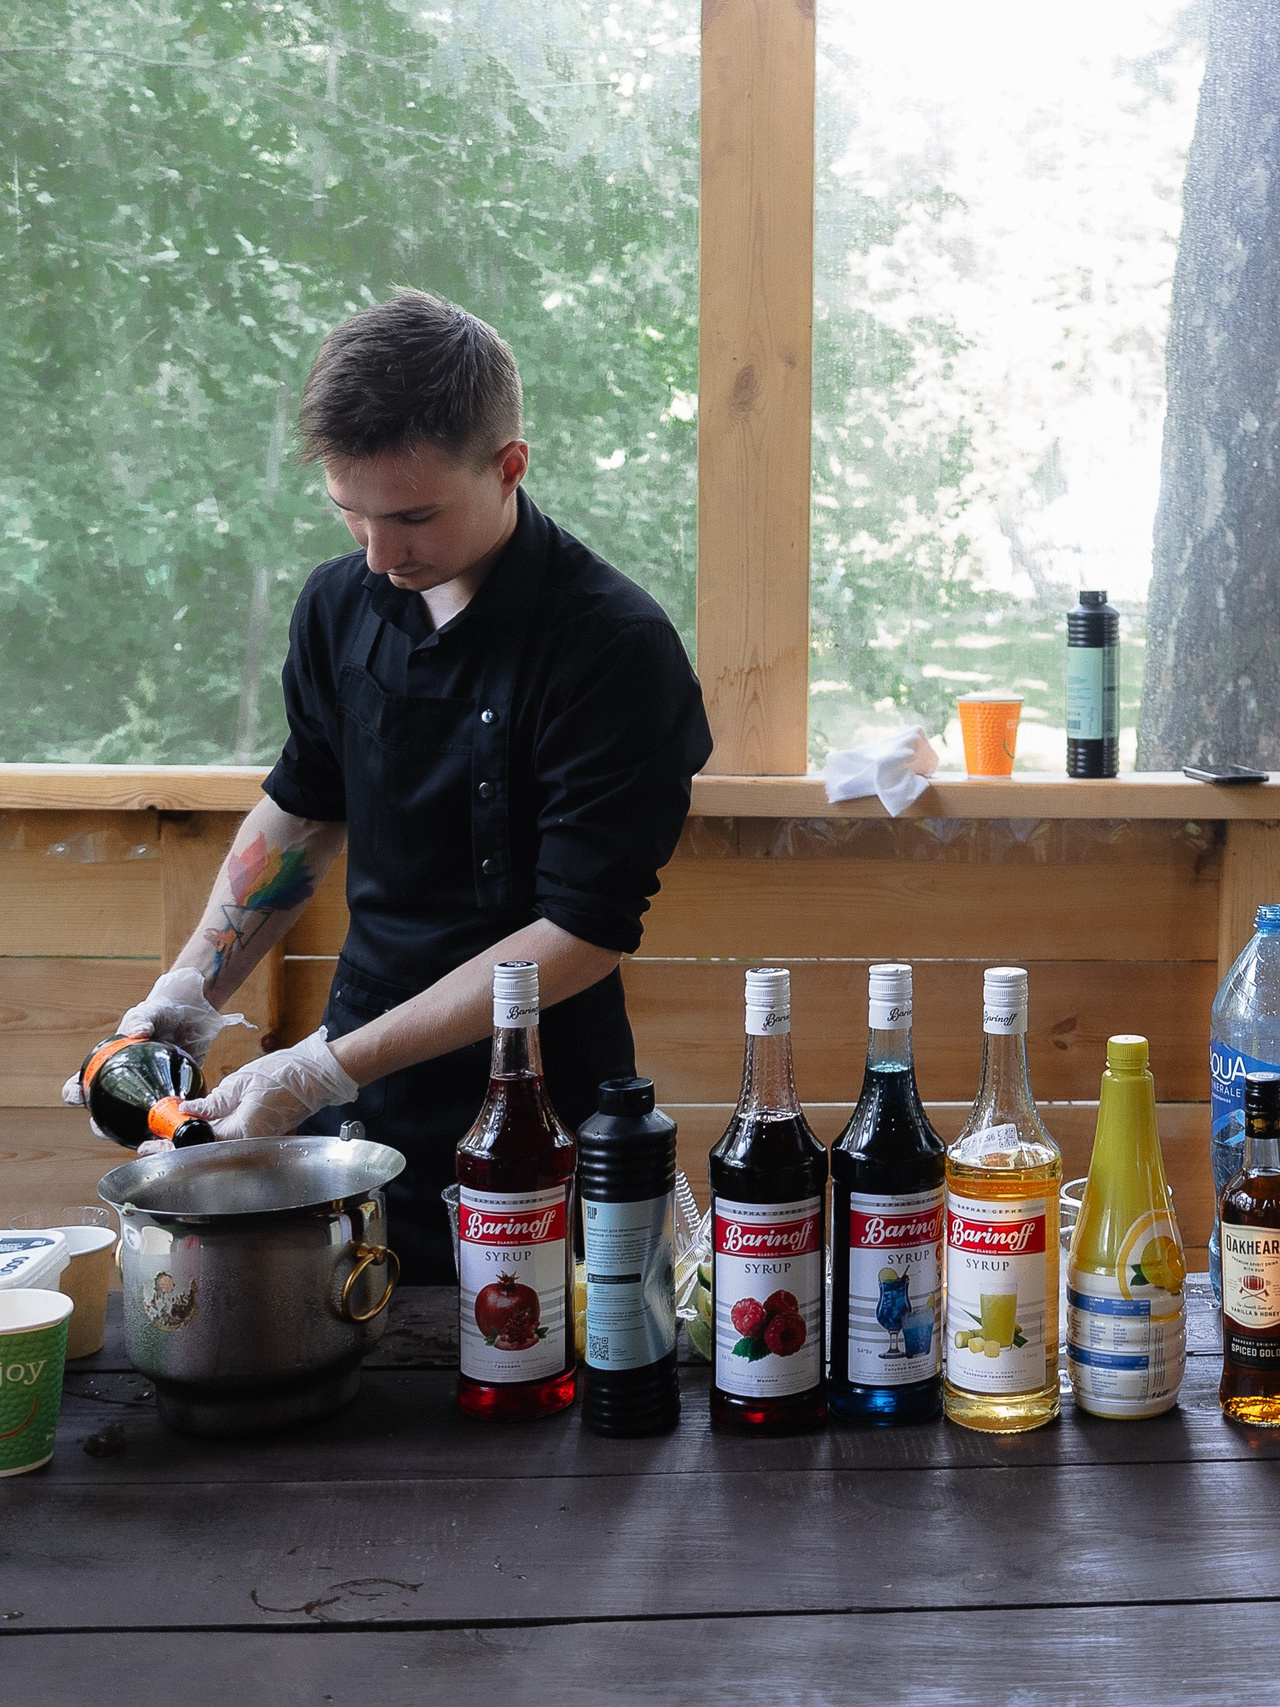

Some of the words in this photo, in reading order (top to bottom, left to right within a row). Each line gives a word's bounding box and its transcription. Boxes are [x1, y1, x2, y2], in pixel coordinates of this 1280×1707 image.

[1210, 1052, 1247, 1086] QUA
[465, 1209, 556, 1240] Barinoff
[860, 1208, 943, 1245] Barinoff
[722, 1220, 814, 1251] Barinoff
[950, 1217, 1036, 1251] Barinoff
[485, 1250, 532, 1262] SYRUP
[887, 1249, 930, 1265] SYRUP
[744, 1262, 791, 1274] SYRUP
[965, 1258, 1010, 1272] SYRUP
[1231, 1305, 1252, 1316] VANILLA
[1231, 1342, 1257, 1357] SPICED
